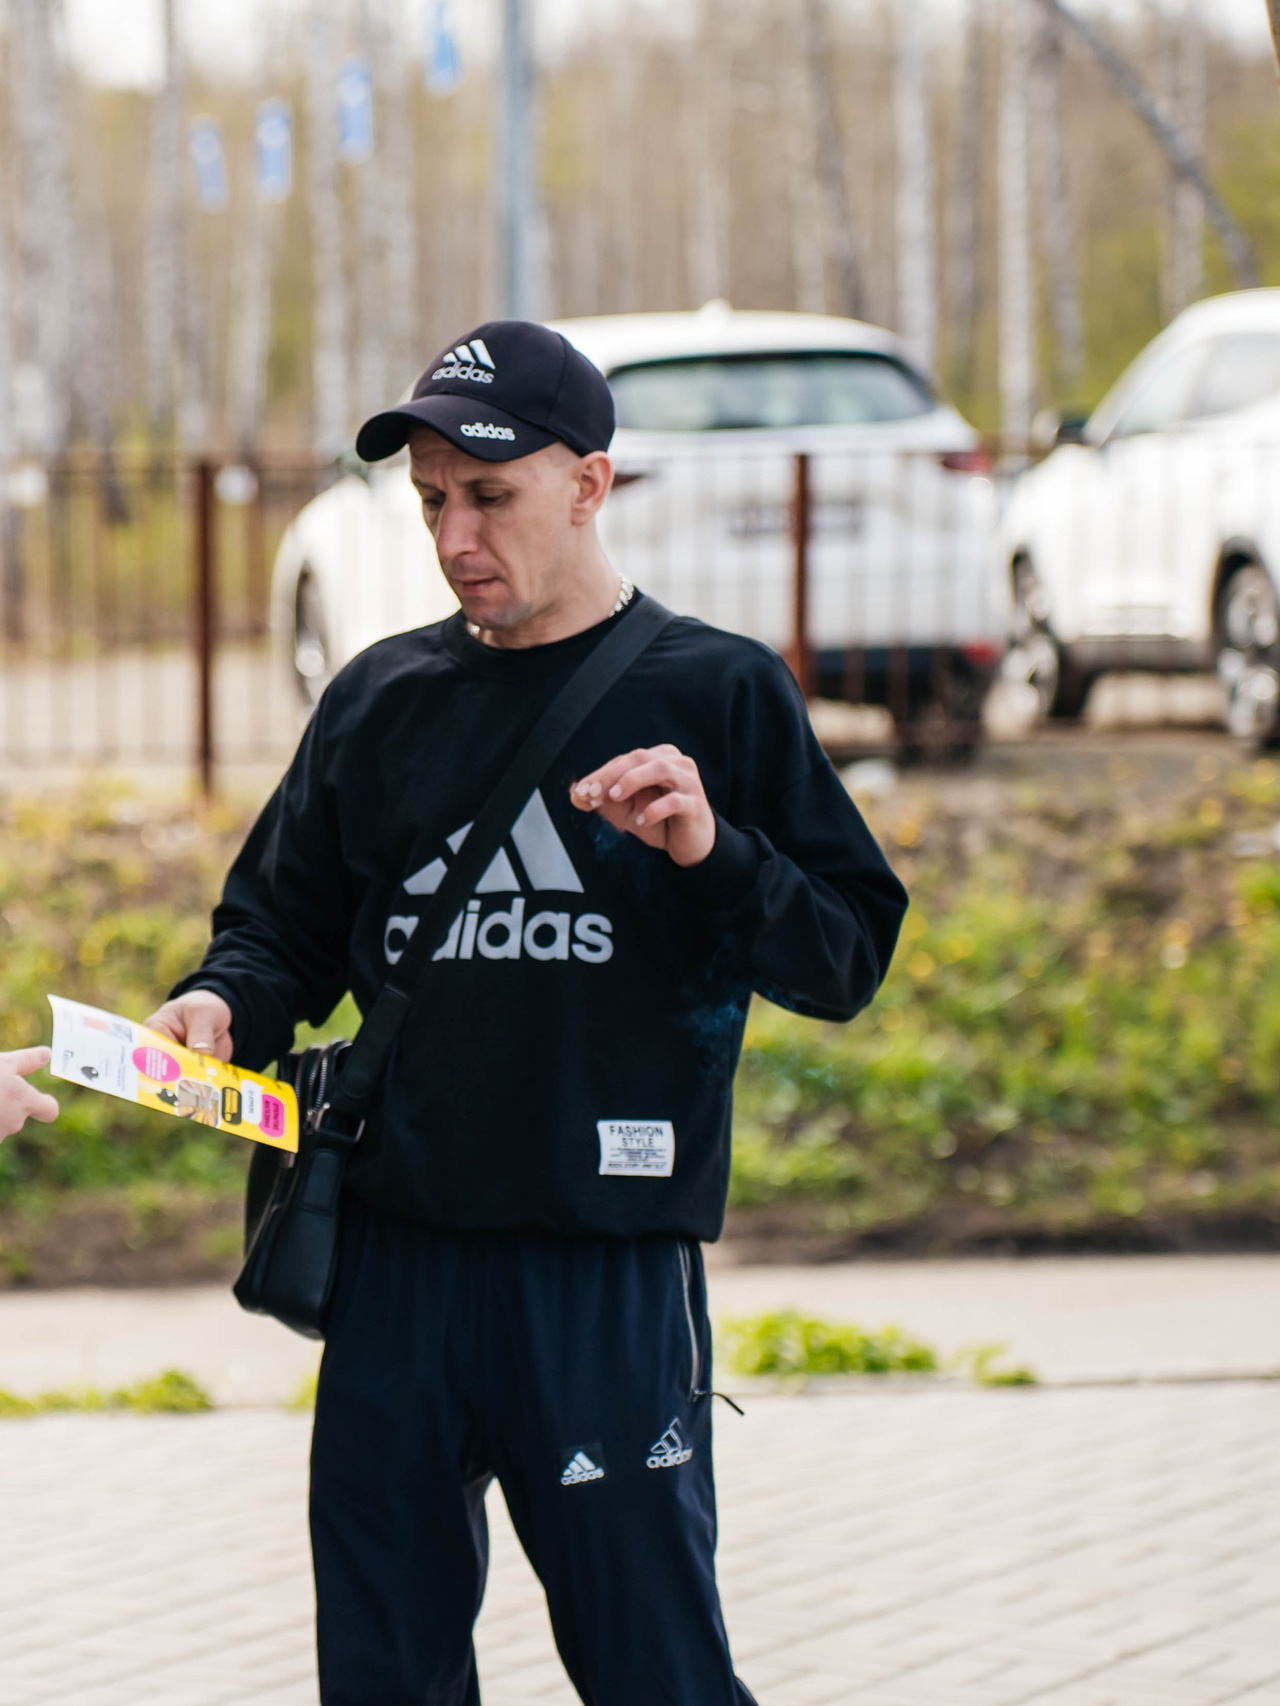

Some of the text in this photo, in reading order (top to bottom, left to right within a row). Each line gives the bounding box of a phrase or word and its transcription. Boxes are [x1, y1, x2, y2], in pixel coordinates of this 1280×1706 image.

[432, 361, 495, 384] adidas
[460, 421, 516, 442] adidas
[609, 1125, 664, 1137] FASHION
[622, 1137, 654, 1147] STYLE
[560, 1466, 605, 1486] adidas
